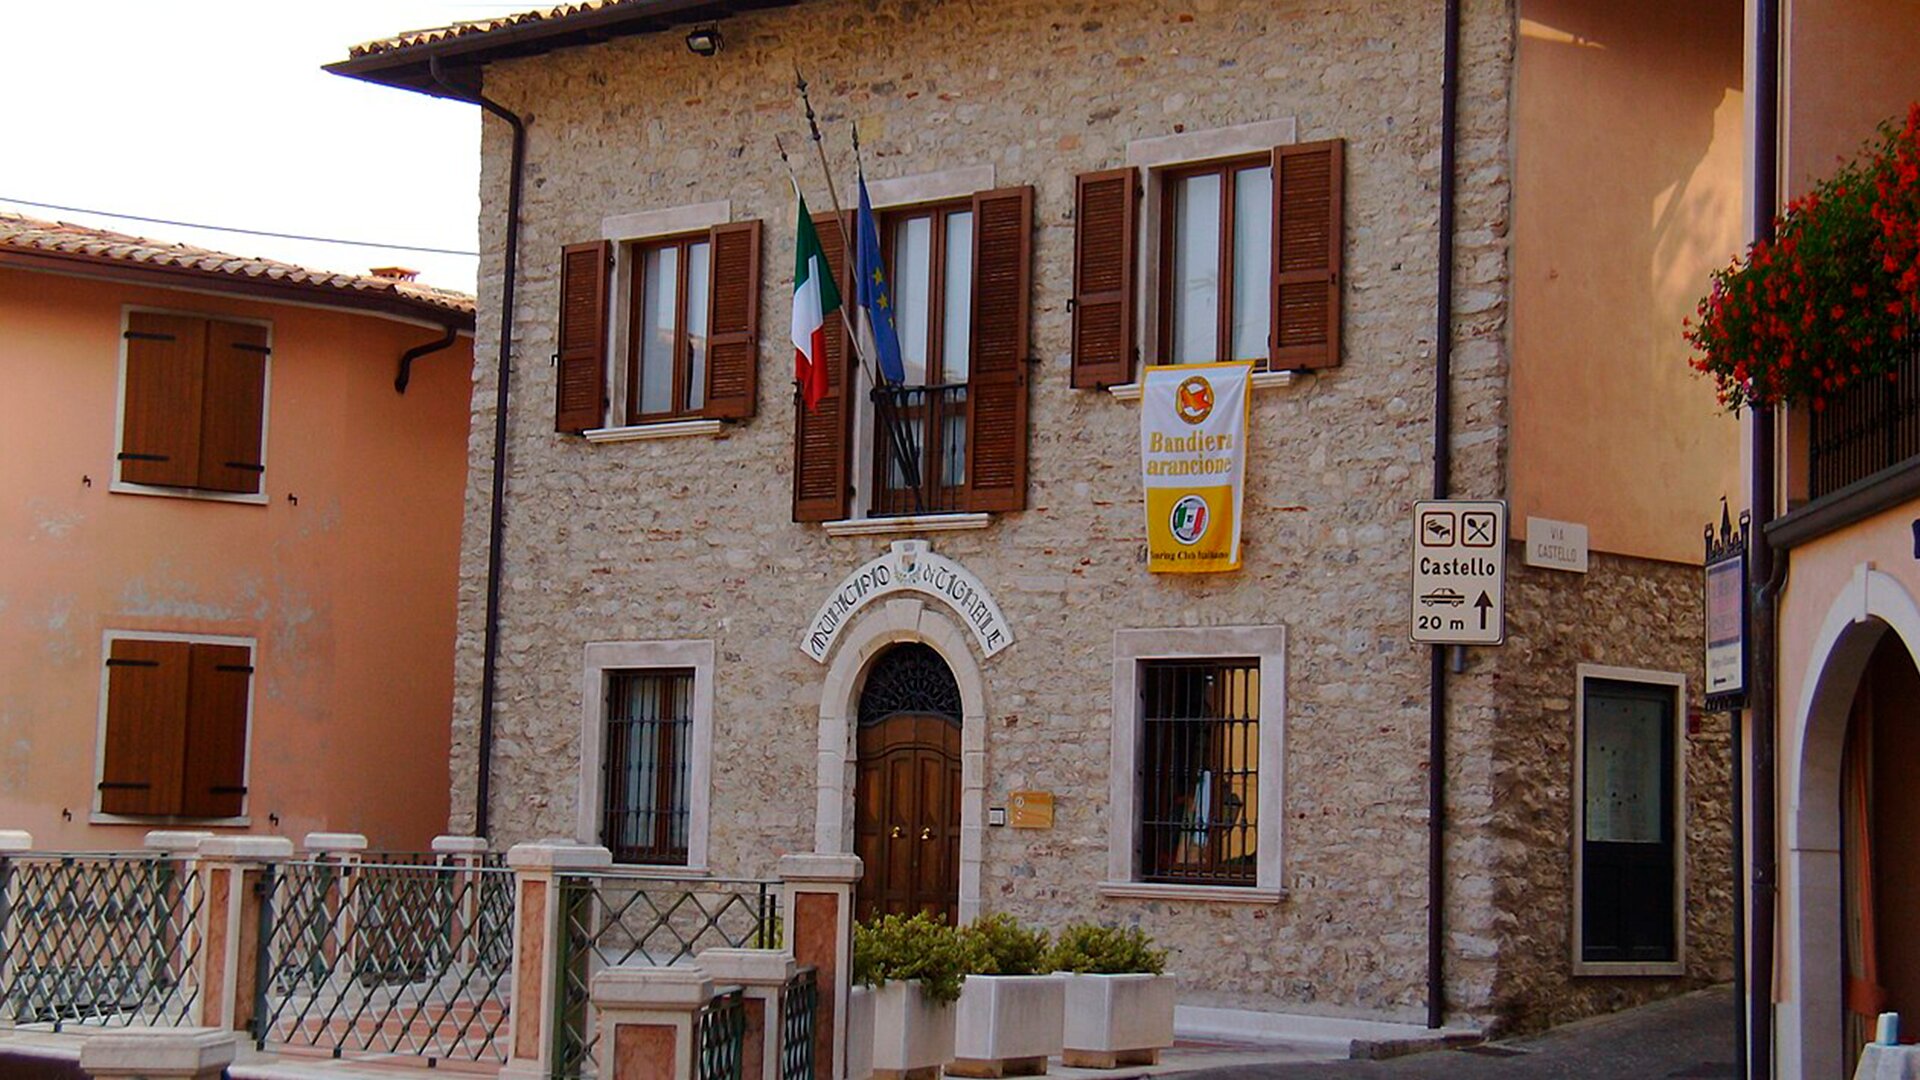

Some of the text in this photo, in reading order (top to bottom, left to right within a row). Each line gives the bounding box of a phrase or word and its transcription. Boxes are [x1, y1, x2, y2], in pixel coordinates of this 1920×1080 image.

[1147, 453, 1232, 475] arancione
[1550, 526, 1563, 541] VIA
[1538, 543, 1577, 562] CASTELLO
[1420, 556, 1495, 576] Castello
[810, 564, 890, 656] MUNICIPIO
[1418, 615, 1464, 630] 20 m
